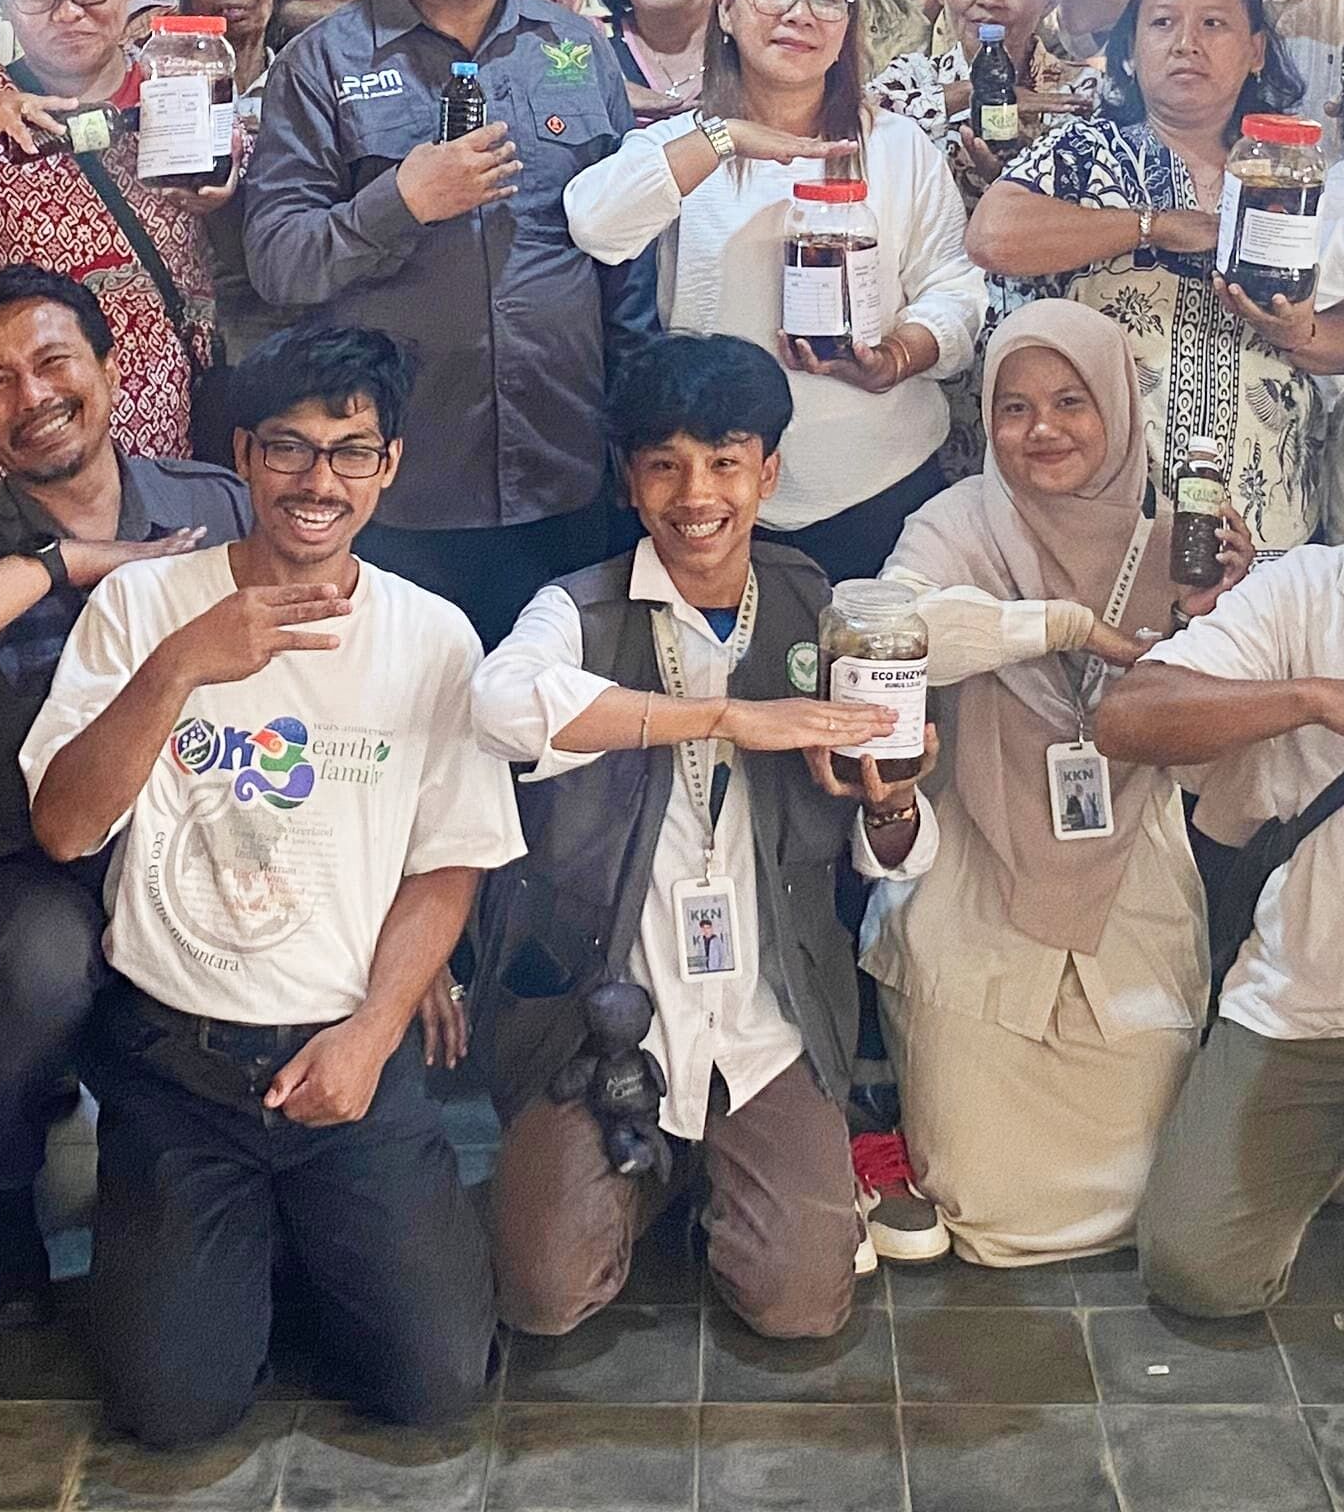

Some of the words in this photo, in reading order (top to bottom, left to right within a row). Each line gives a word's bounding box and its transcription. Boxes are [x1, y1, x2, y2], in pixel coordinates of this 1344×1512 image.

[1108, 573, 1130, 624] NUSANT
[871, 671, 894, 681] ECO
[312, 737, 373, 760] earth
[319, 759, 385, 792] family
[1063, 768, 1094, 783] KKN
[150, 831, 166, 860] eco
[690, 907, 722, 921] KKN
